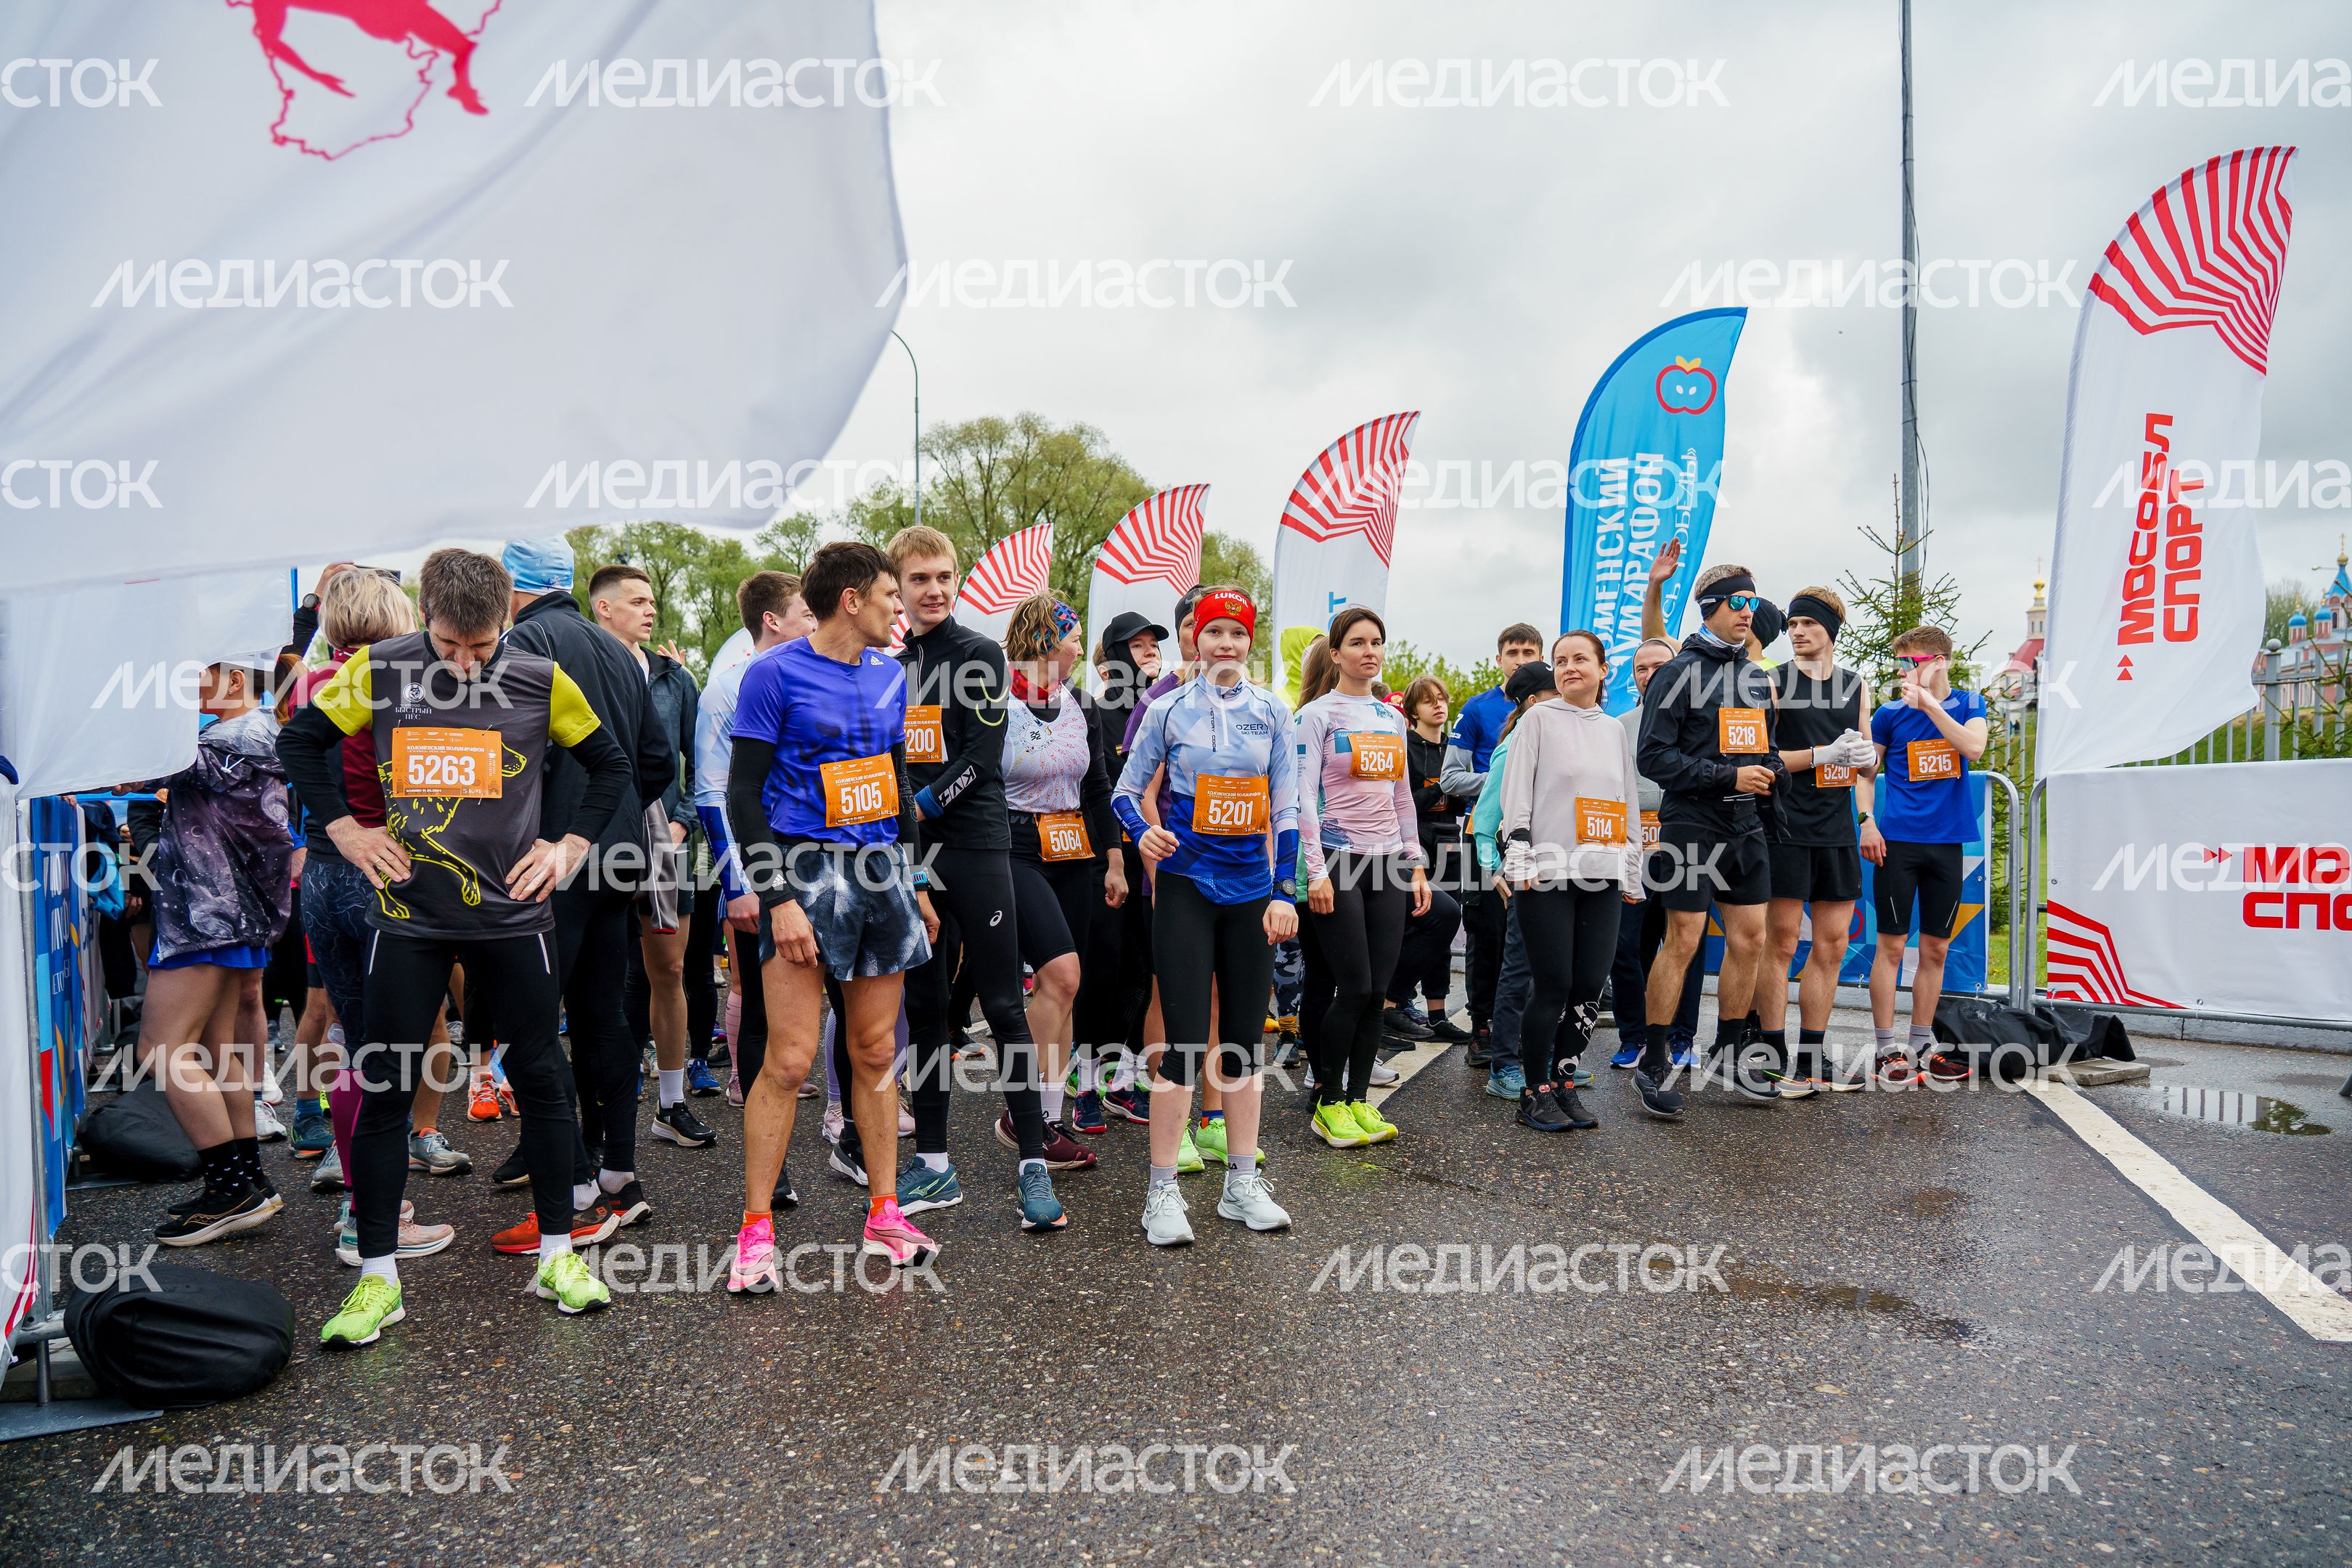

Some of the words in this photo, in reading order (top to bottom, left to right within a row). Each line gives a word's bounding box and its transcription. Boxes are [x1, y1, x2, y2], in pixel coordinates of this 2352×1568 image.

[2117, 413, 2173, 645] МОСОБЛ
[2163, 470, 2205, 642] СПОРТ
[1214, 592, 1249, 608] LUKOIL
[904, 728, 935, 753] 200
[1728, 726, 1756, 746] 5218
[408, 754, 476, 786] 5263
[1360, 751, 1395, 772] 5264
[1919, 754, 1952, 774] 5215
[841, 781, 882, 814] 5105
[1208, 799, 1254, 825] 5201
[1587, 816, 1612, 838] 5114
[1049, 830, 1082, 852] 5064
